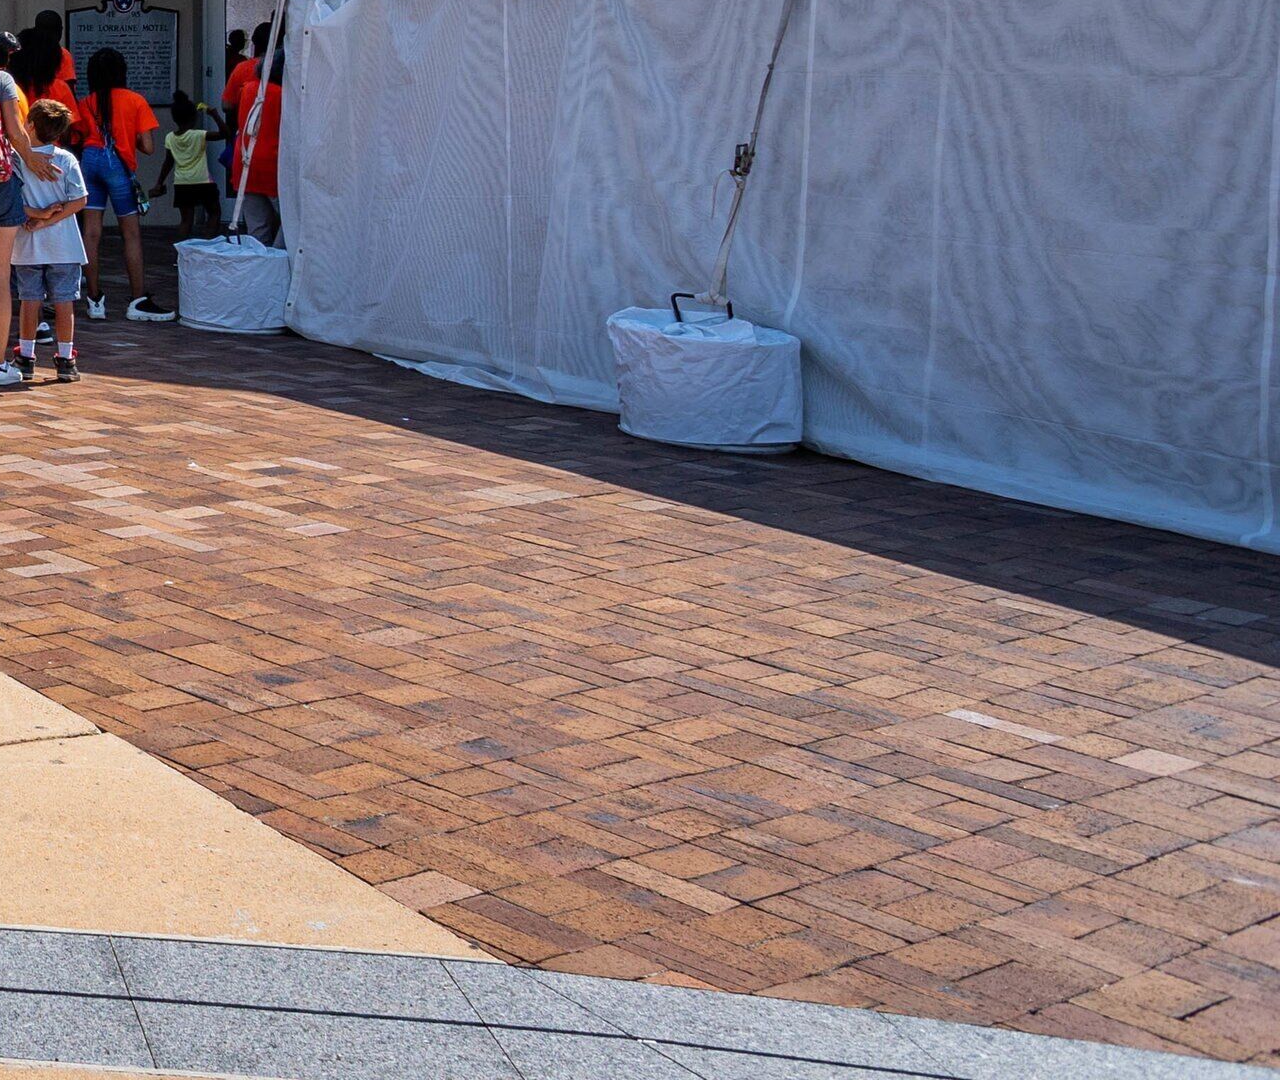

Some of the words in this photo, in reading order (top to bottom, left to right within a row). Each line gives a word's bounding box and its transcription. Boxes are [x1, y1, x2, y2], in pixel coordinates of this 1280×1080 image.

[78, 24, 94, 32] THE
[98, 24, 138, 32] LORRAINE
[142, 24, 169, 32] MOTEL
